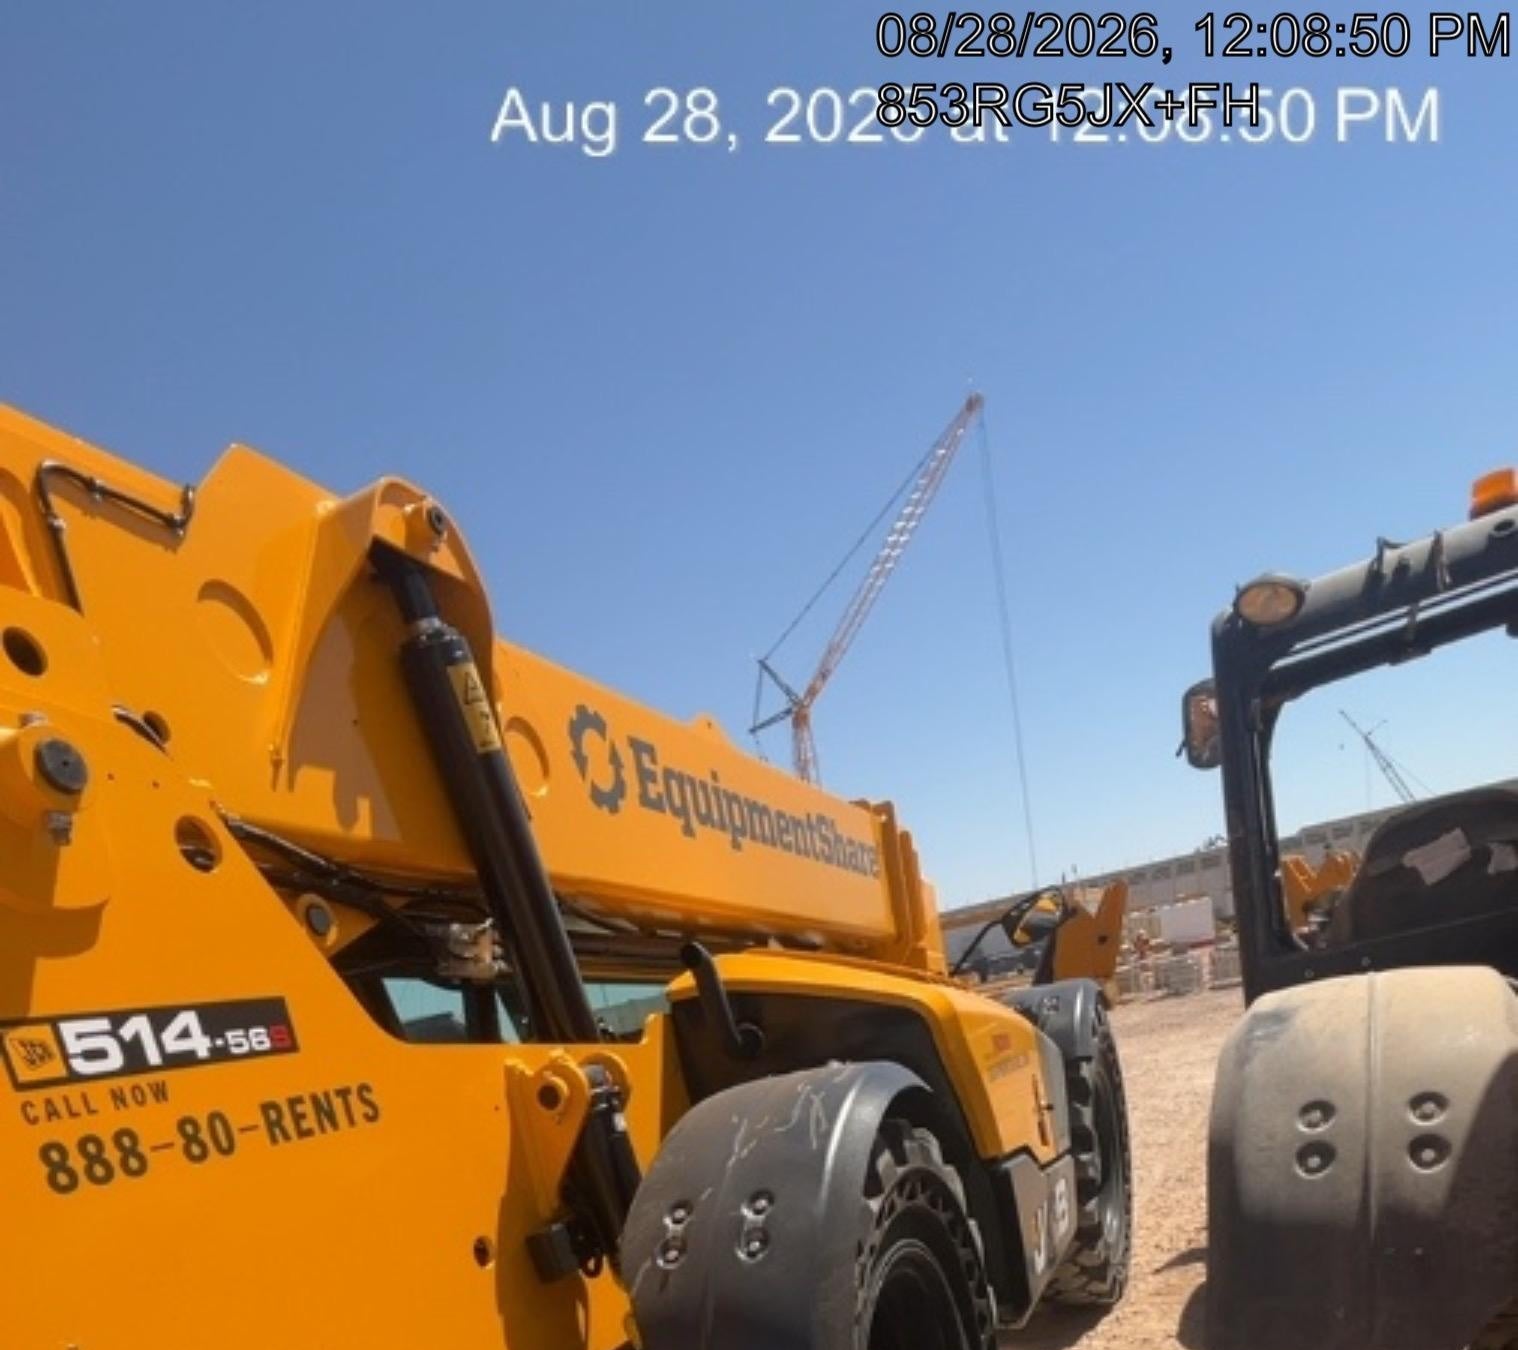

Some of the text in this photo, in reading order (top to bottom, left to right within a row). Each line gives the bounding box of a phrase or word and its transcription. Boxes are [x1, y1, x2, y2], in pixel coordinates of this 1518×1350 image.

[626, 734, 882, 878] EquipmentShare
[20, 1079, 170, 1126] CALL NOW
[38, 1082, 381, 1194] 888-80-RENTS
